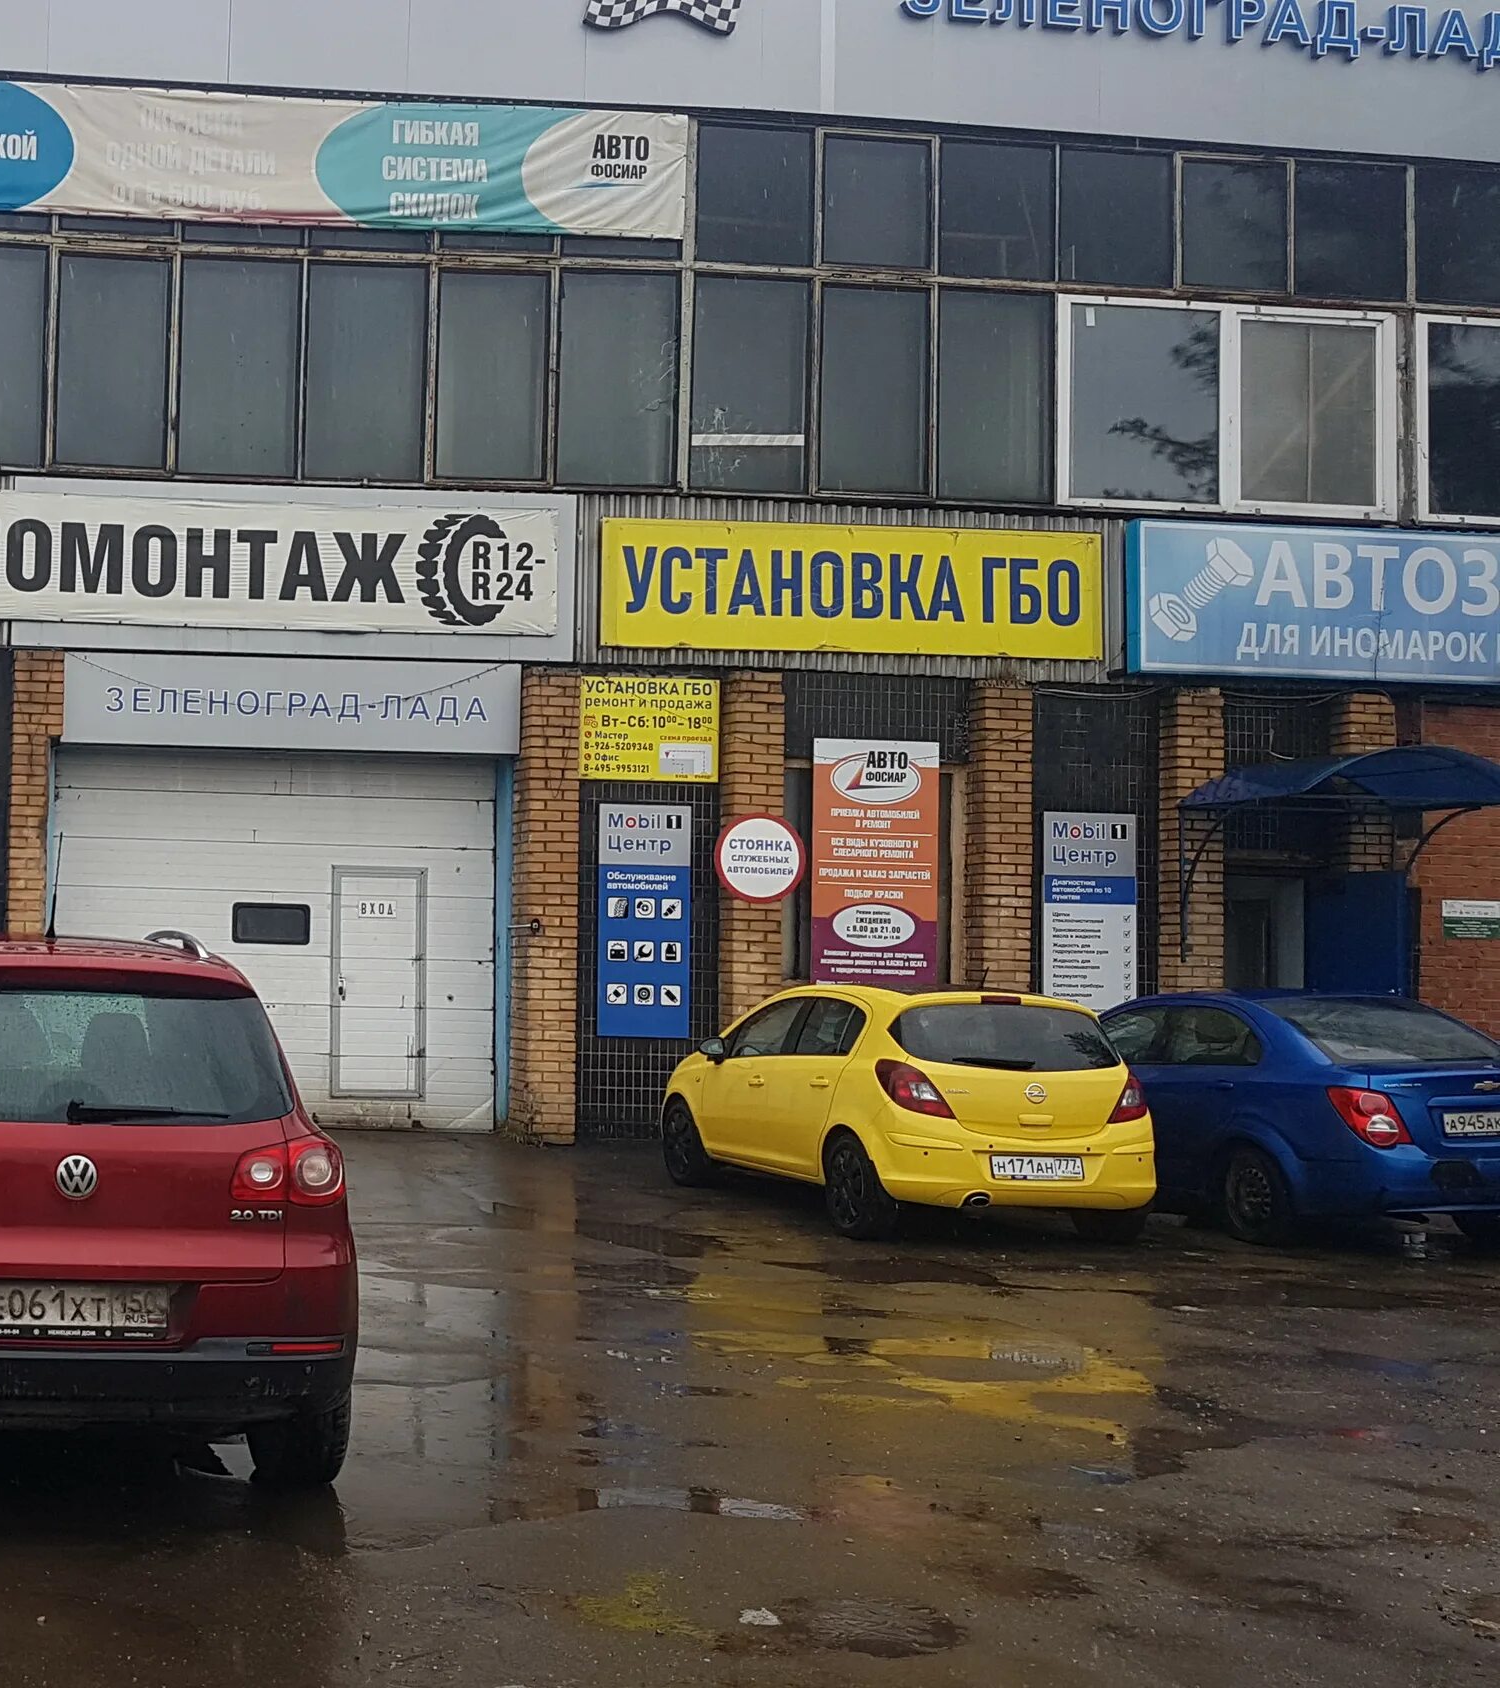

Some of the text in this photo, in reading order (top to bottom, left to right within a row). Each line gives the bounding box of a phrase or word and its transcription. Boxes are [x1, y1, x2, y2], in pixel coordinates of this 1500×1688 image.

[392, 118, 480, 148] ГИБКАЯ
[592, 133, 651, 162] АВТО
[105, 139, 277, 176] ОДНОЙ ДЕТАЛИ
[381, 154, 489, 184] СИСТЕМА
[590, 160, 649, 181] ФОСИАР
[388, 192, 480, 223] СКИДОК
[1254, 540, 1500, 617] АВТОЗ
[471, 571, 534, 602] R24
[621, 545, 1081, 628] УСТАНОВКА ГБО
[1236, 622, 1300, 662] ДЛЯ
[1310, 624, 1488, 664] ИНОМАРОК
[585, 680, 712, 696] УСТАНОВКА ГБО
[105, 686, 490, 727] ЗЕЛЕНОГРАД-ЛАДА
[585, 698, 712, 711] ремонт и продажа
[594, 731, 629, 741] Мастер
[594, 753, 620, 762] Офис
[866, 751, 909, 770] АВТО
[583, 764, 650, 774] 8-495-9953121
[865, 771, 907, 783] ФОСИАР
[866, 808, 920, 820] АВТОМОБИЛЕЙ
[608, 813, 682, 829] Mobil 1
[862, 820, 892, 830] РЕМОНТ
[1052, 822, 1128, 840] Mobil 1
[607, 835, 672, 855] Центр
[729, 838, 793, 852] СТОЯНКА
[831, 837, 919, 849] ВСЕ ВИДЫ КУЗОВНОГО И
[731, 854, 790, 865] СЛУЖЕБНЫХ
[833, 848, 914, 859] СЛЕСАРНОГО РЕМОНТА
[1052, 846, 1117, 866] Центр
[607, 871, 677, 882] Обслуживание
[726, 865, 794, 876] АВТОМОБИЛЕЙ
[819, 867, 855, 878] ПРОДАЖА
[863, 869, 887, 879] ЗАКАЗ
[888, 869, 931, 880] ЗАПЧАСТЕЙ
[606, 881, 669, 891] автомобилей
[1052, 878, 1096, 887] Диагностика
[844, 889, 904, 899] ПОДБОР КРАСКИ
[1052, 886, 1094, 894] автомобиля
[360, 902, 395, 916] ВХОД
[880, 926, 901, 934] 21.00
[996, 1157, 1077, 1175] Н171АН 777
[257, 1209, 283, 1220] TDI
[124, 1313, 148, 1324] RUS
